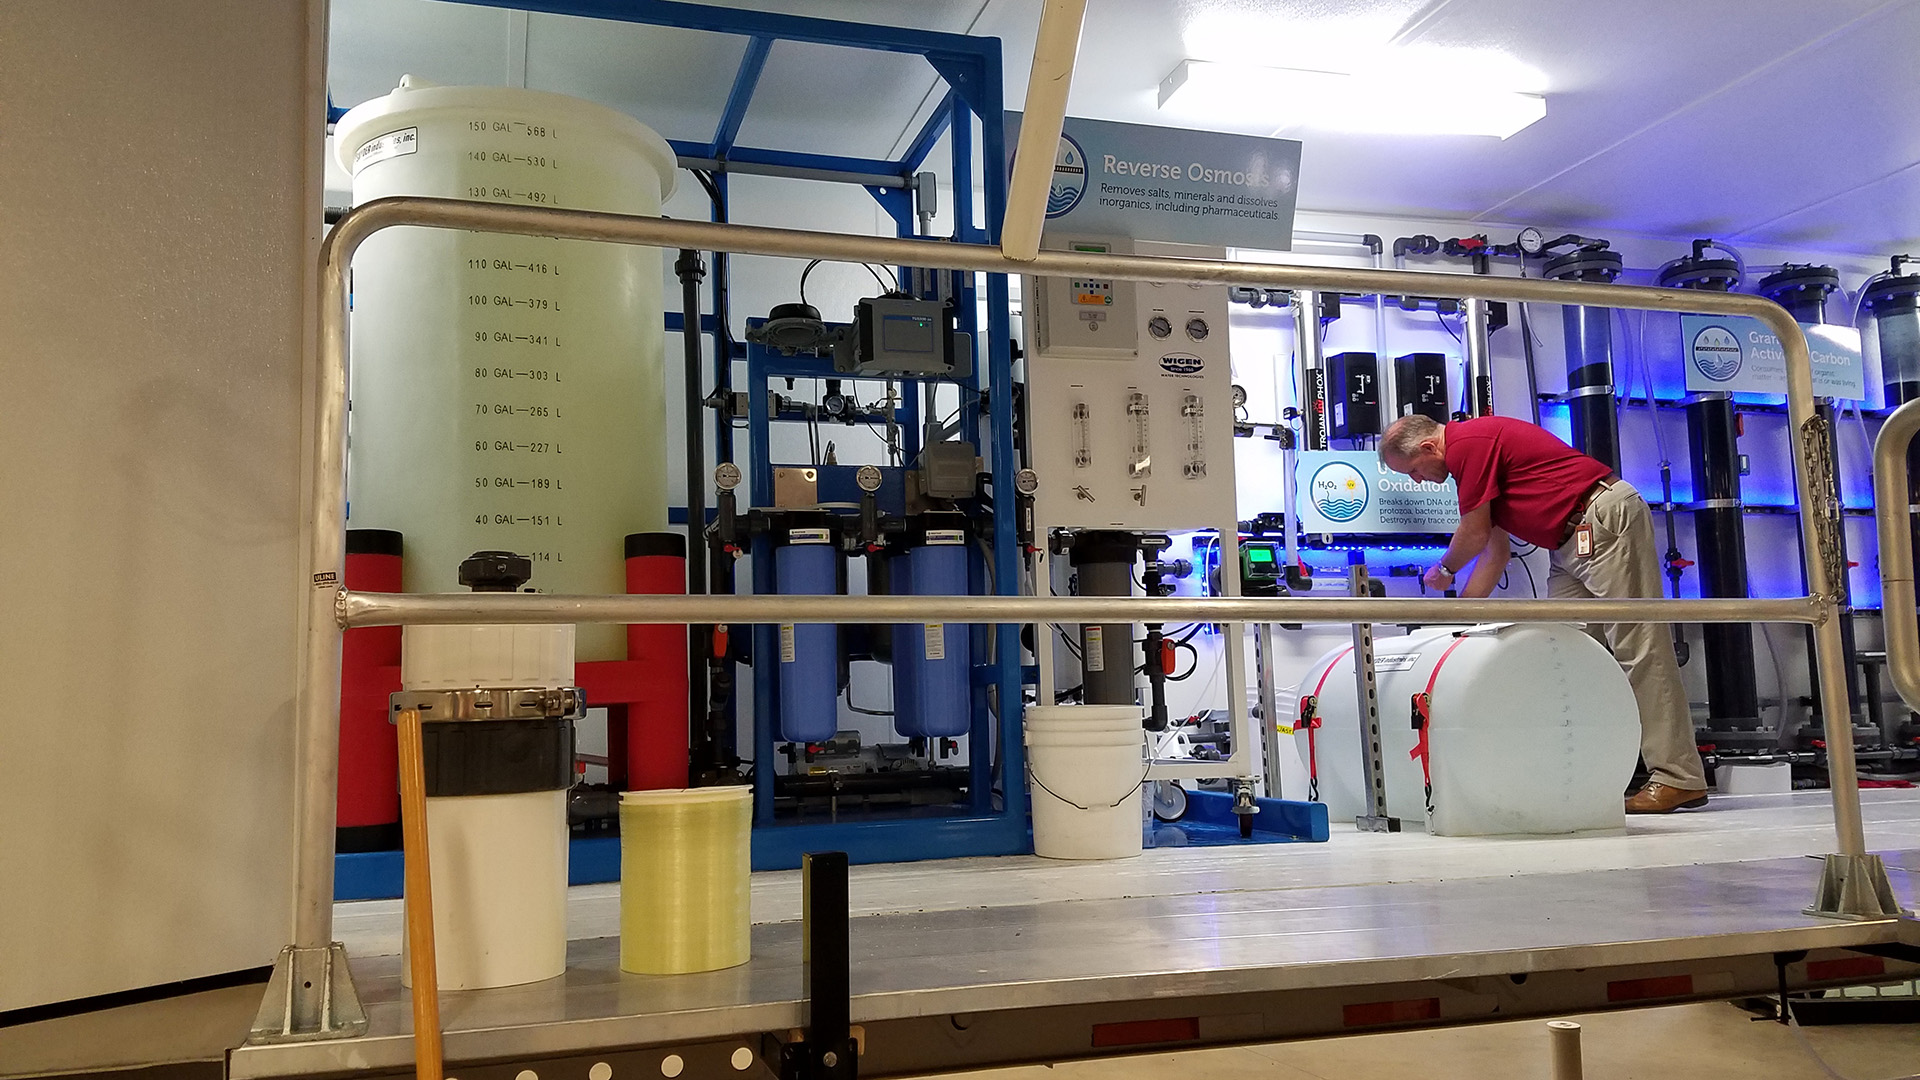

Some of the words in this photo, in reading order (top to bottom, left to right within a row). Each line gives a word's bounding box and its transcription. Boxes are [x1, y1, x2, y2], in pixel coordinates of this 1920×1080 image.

[468, 120, 487, 132] 150
[492, 121, 512, 133] GAL
[526, 125, 546, 138] 568
[467, 151, 487, 162] 140
[491, 151, 512, 164] GAL
[526, 155, 546, 168] 530
[1103, 154, 1182, 180] Reverse
[468, 186, 488, 198] 130
[492, 187, 513, 200] GAL
[526, 190, 547, 204] 492
[1100, 182, 1146, 197] Removes
[1148, 187, 1171, 199] salts,
[1174, 190, 1215, 202] minerals
[1217, 194, 1235, 204] and
[1237, 194, 1278, 208] dissolves
[1099, 195, 1152, 211] inorganics,
[1155, 200, 1200, 216] including
[1202, 204, 1279, 221] pharmaceuticals.
[467, 258, 488, 270] 110
[492, 259, 513, 271] GAL
[527, 262, 548, 275] 416
[468, 294, 488, 306] 100
[492, 295, 514, 307] GAL
[527, 298, 549, 311] 379
[474, 331, 488, 343] 90
[493, 332, 514, 344] GAL
[528, 334, 549, 346] 341
[1162, 357, 1202, 366] WIGEN
[1810, 350, 1851, 367] Carbon
[474, 367, 488, 379] 80
[493, 367, 515, 379] GAL
[528, 369, 549, 381] 303
[475, 403, 488, 415] 70
[493, 403, 515, 416] GAL
[529, 406, 549, 418] 265
[474, 439, 489, 452] 60
[493, 440, 515, 452] GAL
[529, 441, 550, 454] 227
[475, 477, 489, 488] 50
[494, 476, 516, 488] GAL
[530, 478, 550, 490] 189
[1377, 478, 1451, 493] Oxidation
[1378, 497, 1403, 506] Breaks
[1404, 498, 1425, 506] down
[1426, 498, 1443, 506] DNA
[1444, 498, 1452, 506] of
[1415, 507, 1444, 515] bacteria
[1444, 507, 1458, 515] and
[474, 514, 489, 525] 40
[494, 513, 515, 525] GAL
[530, 515, 550, 526] 151
[1380, 515, 1412, 526] Destroys
[1413, 516, 1427, 526] any
[1427, 516, 1446, 524] trace
[531, 551, 550, 562] 114
[314, 572, 336, 582] ULINE
